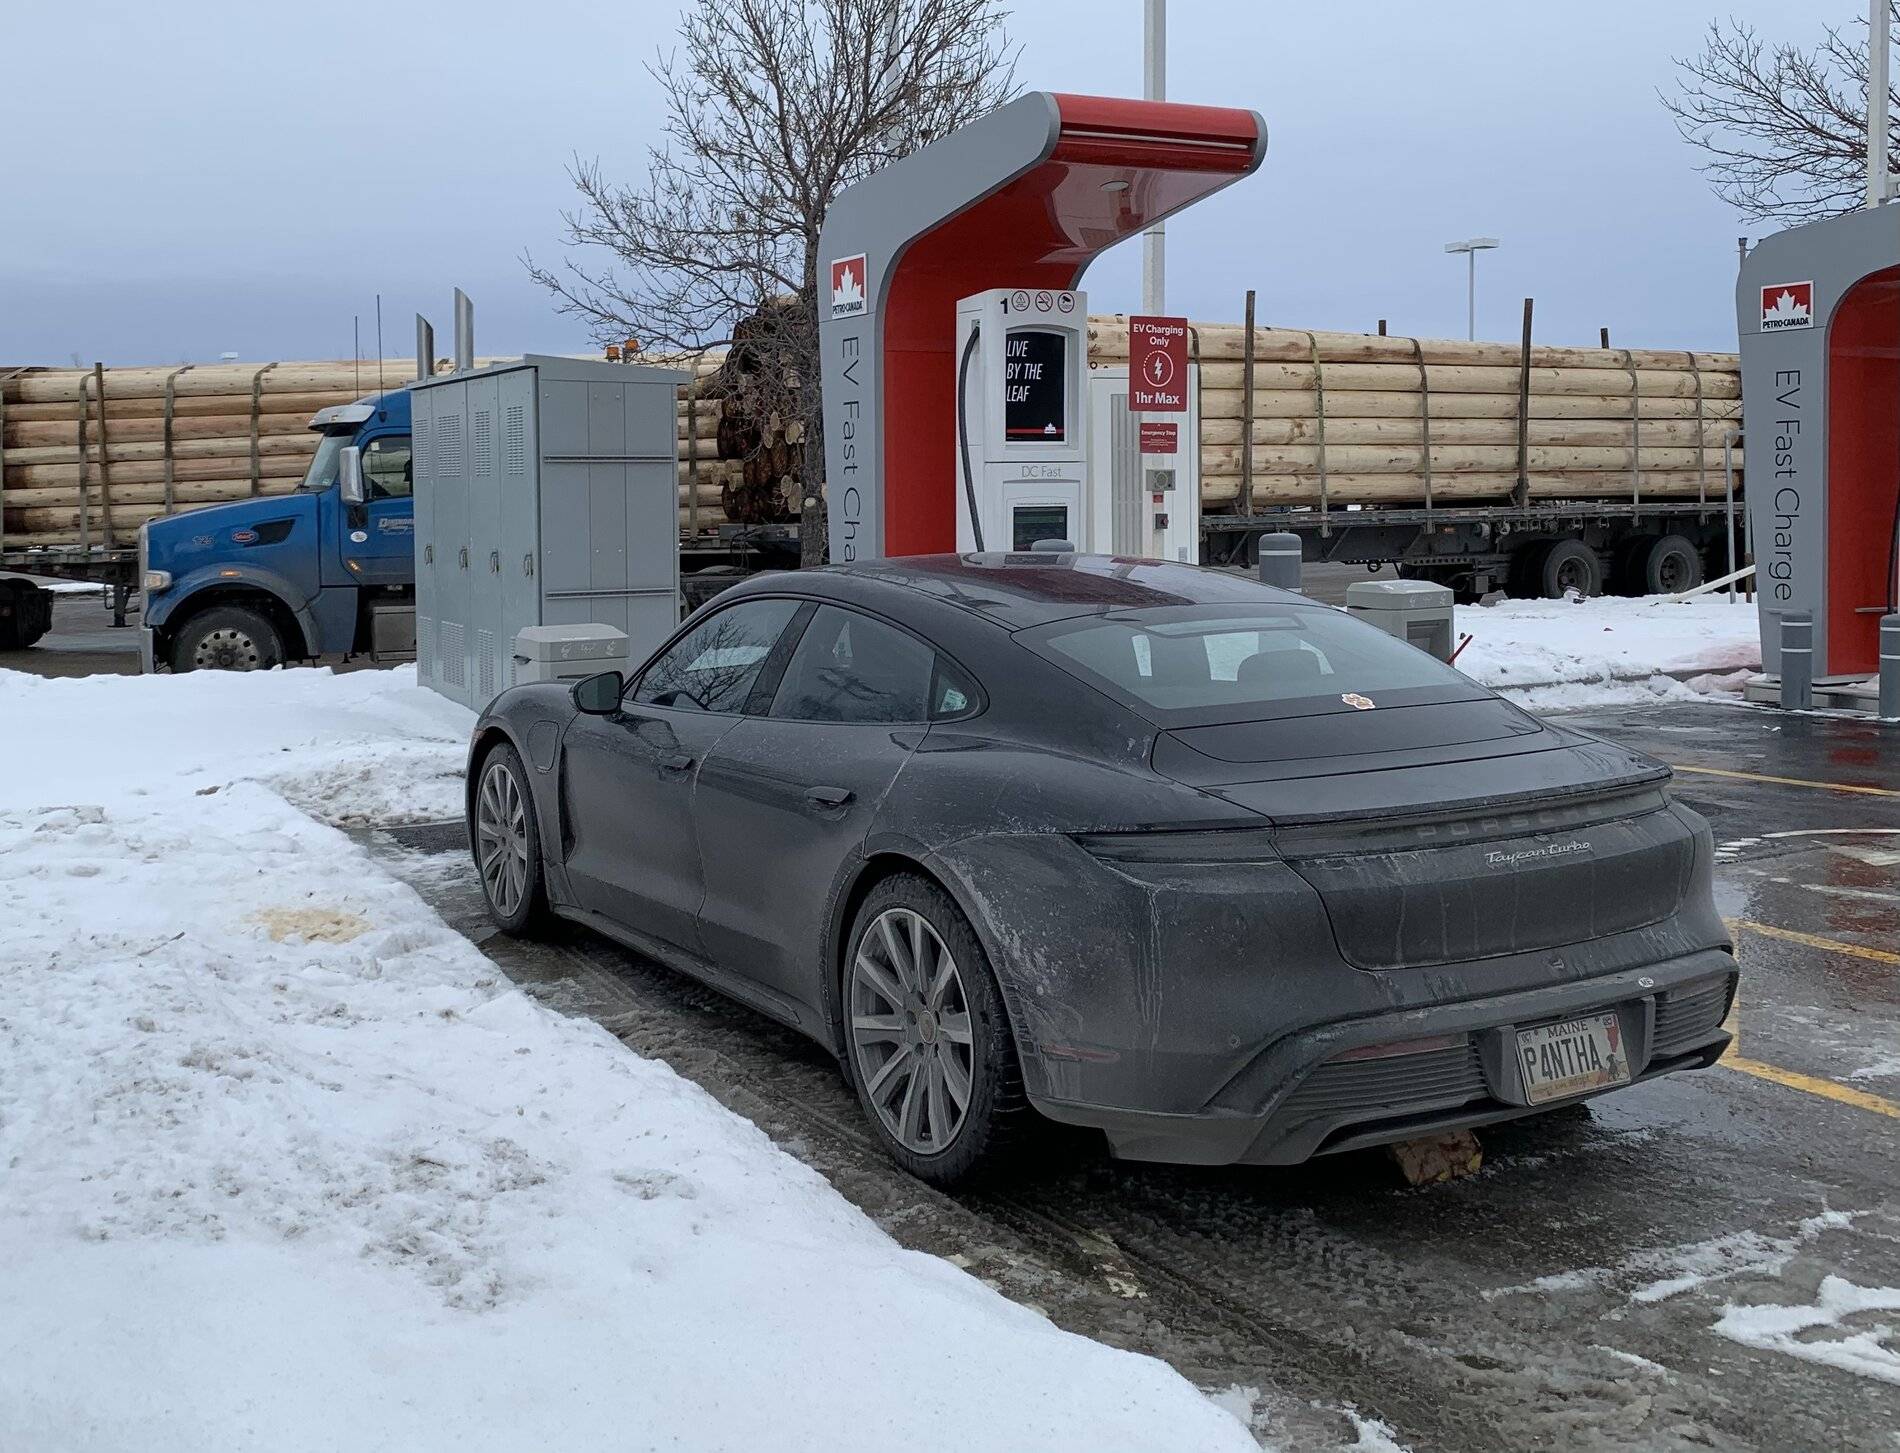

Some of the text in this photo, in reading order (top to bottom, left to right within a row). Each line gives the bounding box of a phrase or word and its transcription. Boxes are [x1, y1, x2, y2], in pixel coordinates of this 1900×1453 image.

[1000, 298, 1008, 314] 1
[1133, 324, 1184, 336] EV Charging
[1762, 317, 1809, 329] PETRO-CANADA
[1007, 341, 1029, 357] LIVE
[1149, 336, 1170, 347] Only
[842, 336, 859, 386] EV
[1007, 363, 1043, 380] BY THE
[1007, 386, 1030, 402] LEAF
[1135, 392, 1180, 404] 1hr Max
[842, 401, 860, 475] Fast
[1021, 465, 1062, 477] DC Fast
[1768, 369, 1801, 601] EV Fast Charge
[1485, 849, 1546, 864] Taycan
[1547, 1020, 1588, 1038] MAINE
[1523, 1033, 1604, 1085] P4NTHA
